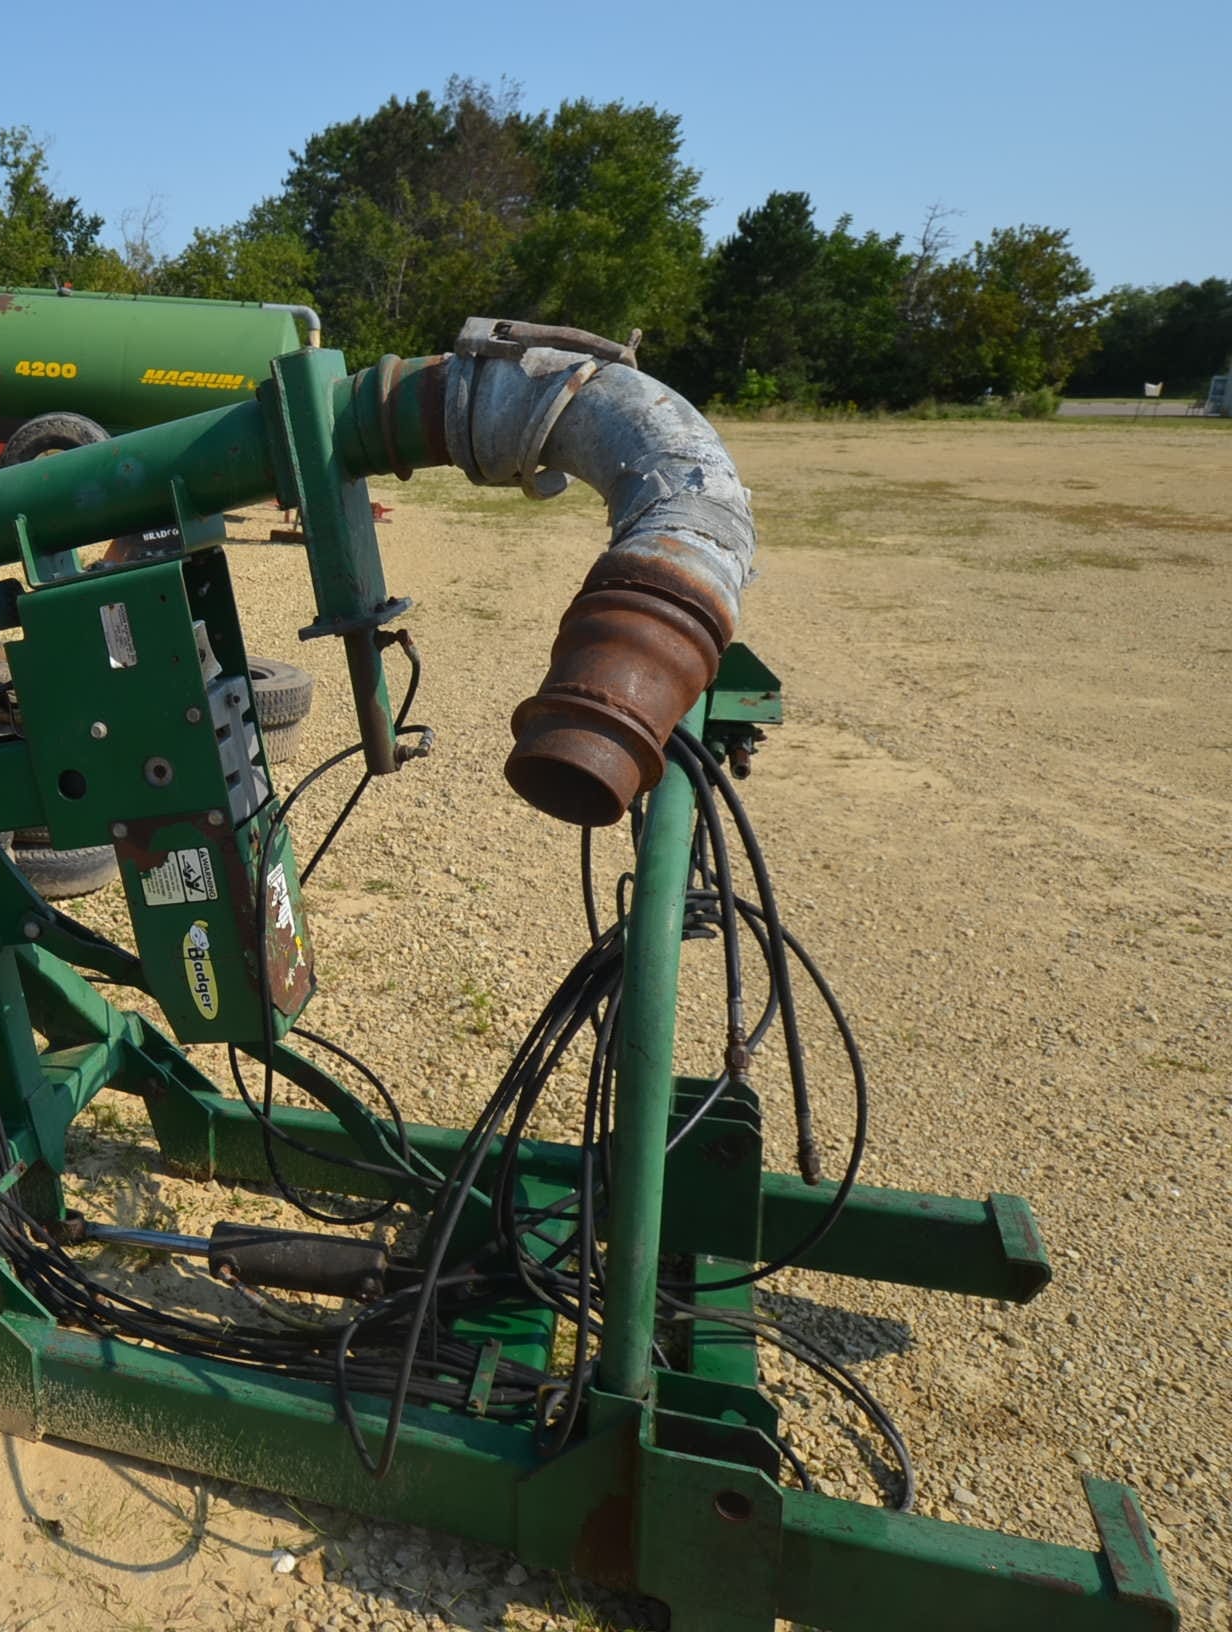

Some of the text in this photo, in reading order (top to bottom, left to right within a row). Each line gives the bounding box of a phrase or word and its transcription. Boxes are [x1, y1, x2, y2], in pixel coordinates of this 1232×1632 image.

[15, 360, 78, 379] 4200
[140, 368, 245, 390] MAGNUM
[201, 857, 217, 899] WARNING
[187, 946, 213, 1012] Badger
